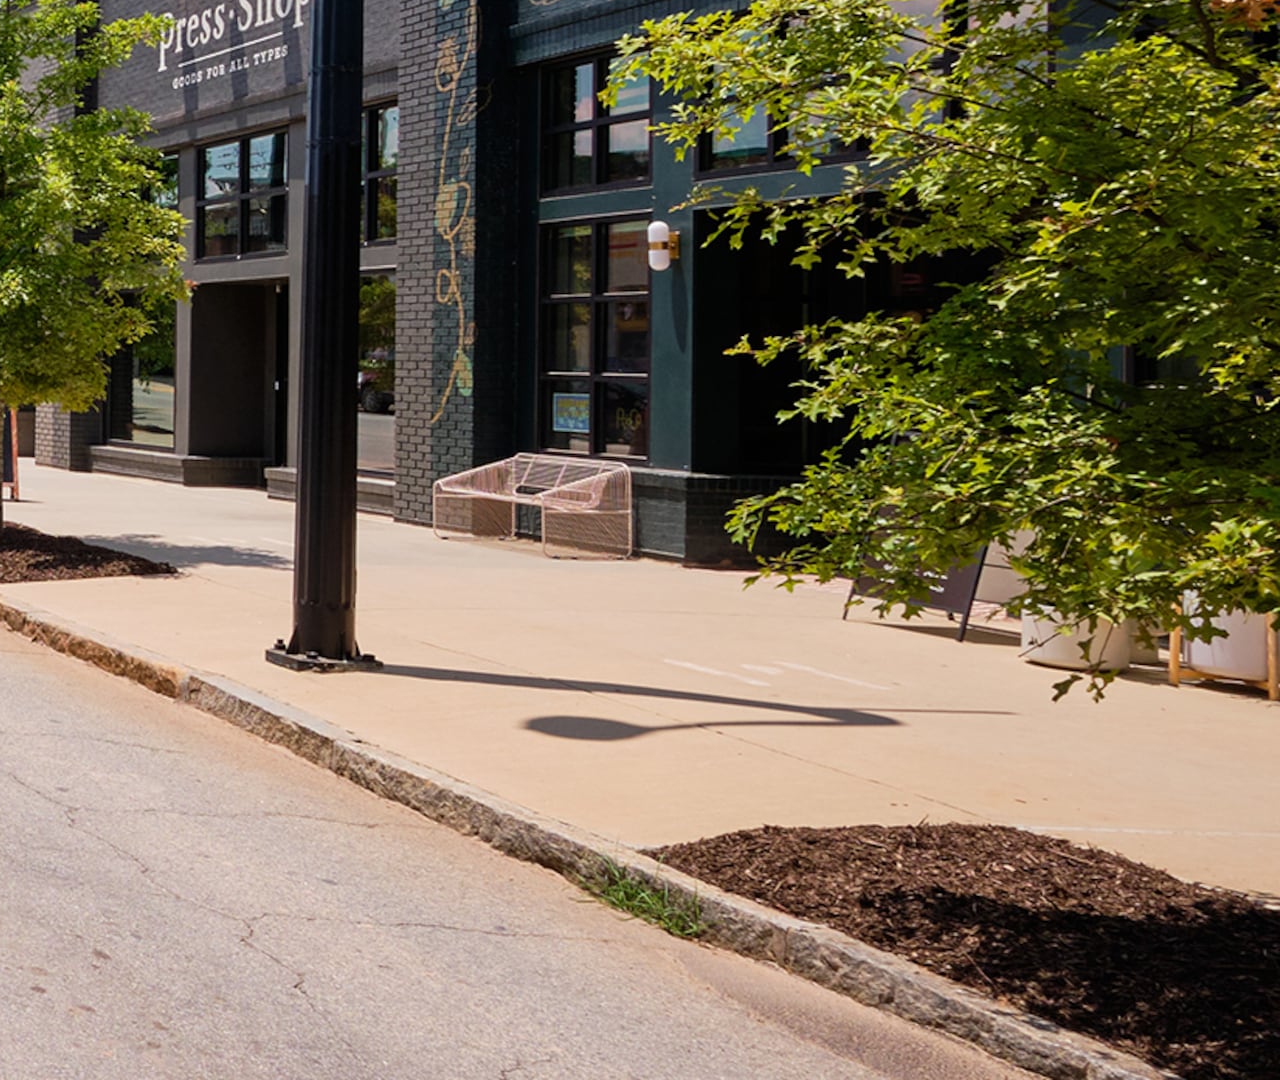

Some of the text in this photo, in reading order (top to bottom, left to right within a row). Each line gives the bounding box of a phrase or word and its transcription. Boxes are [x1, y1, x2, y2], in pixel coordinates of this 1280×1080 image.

[157, 4, 225, 72] Press
[172, 45, 288, 89] GOODS FOR ALL TYPES
